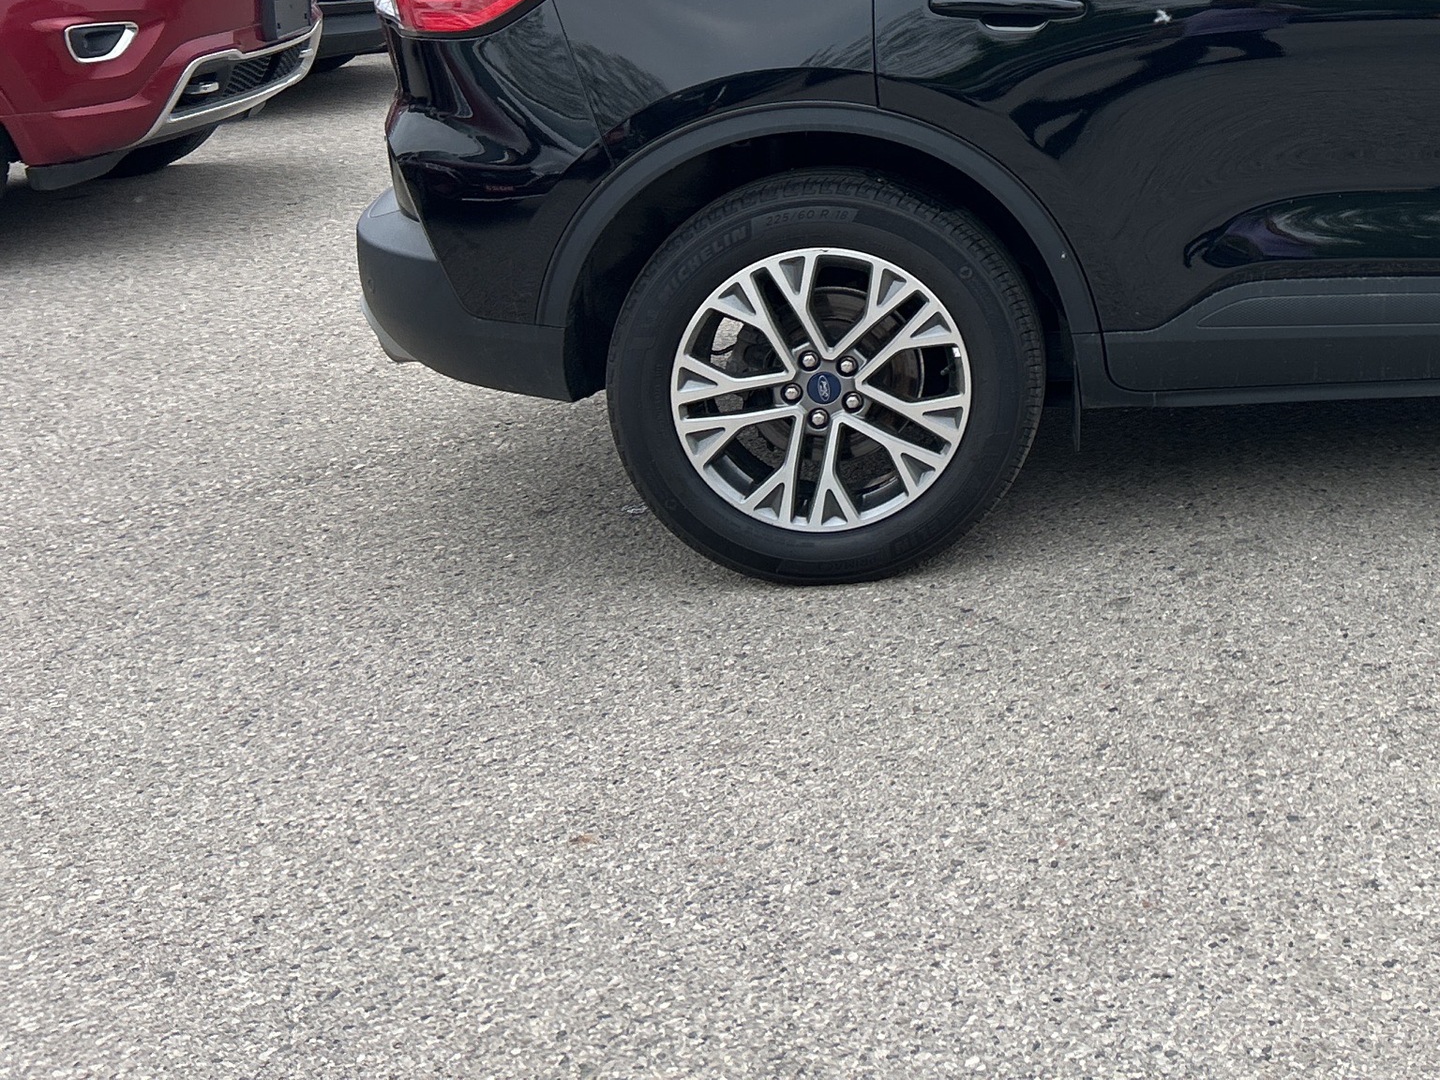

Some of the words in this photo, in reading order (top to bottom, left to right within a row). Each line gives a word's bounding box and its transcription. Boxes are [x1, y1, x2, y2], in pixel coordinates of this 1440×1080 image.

[765, 210, 815, 227] 225/60
[819, 209, 829, 220] R
[835, 209, 848, 220] 18
